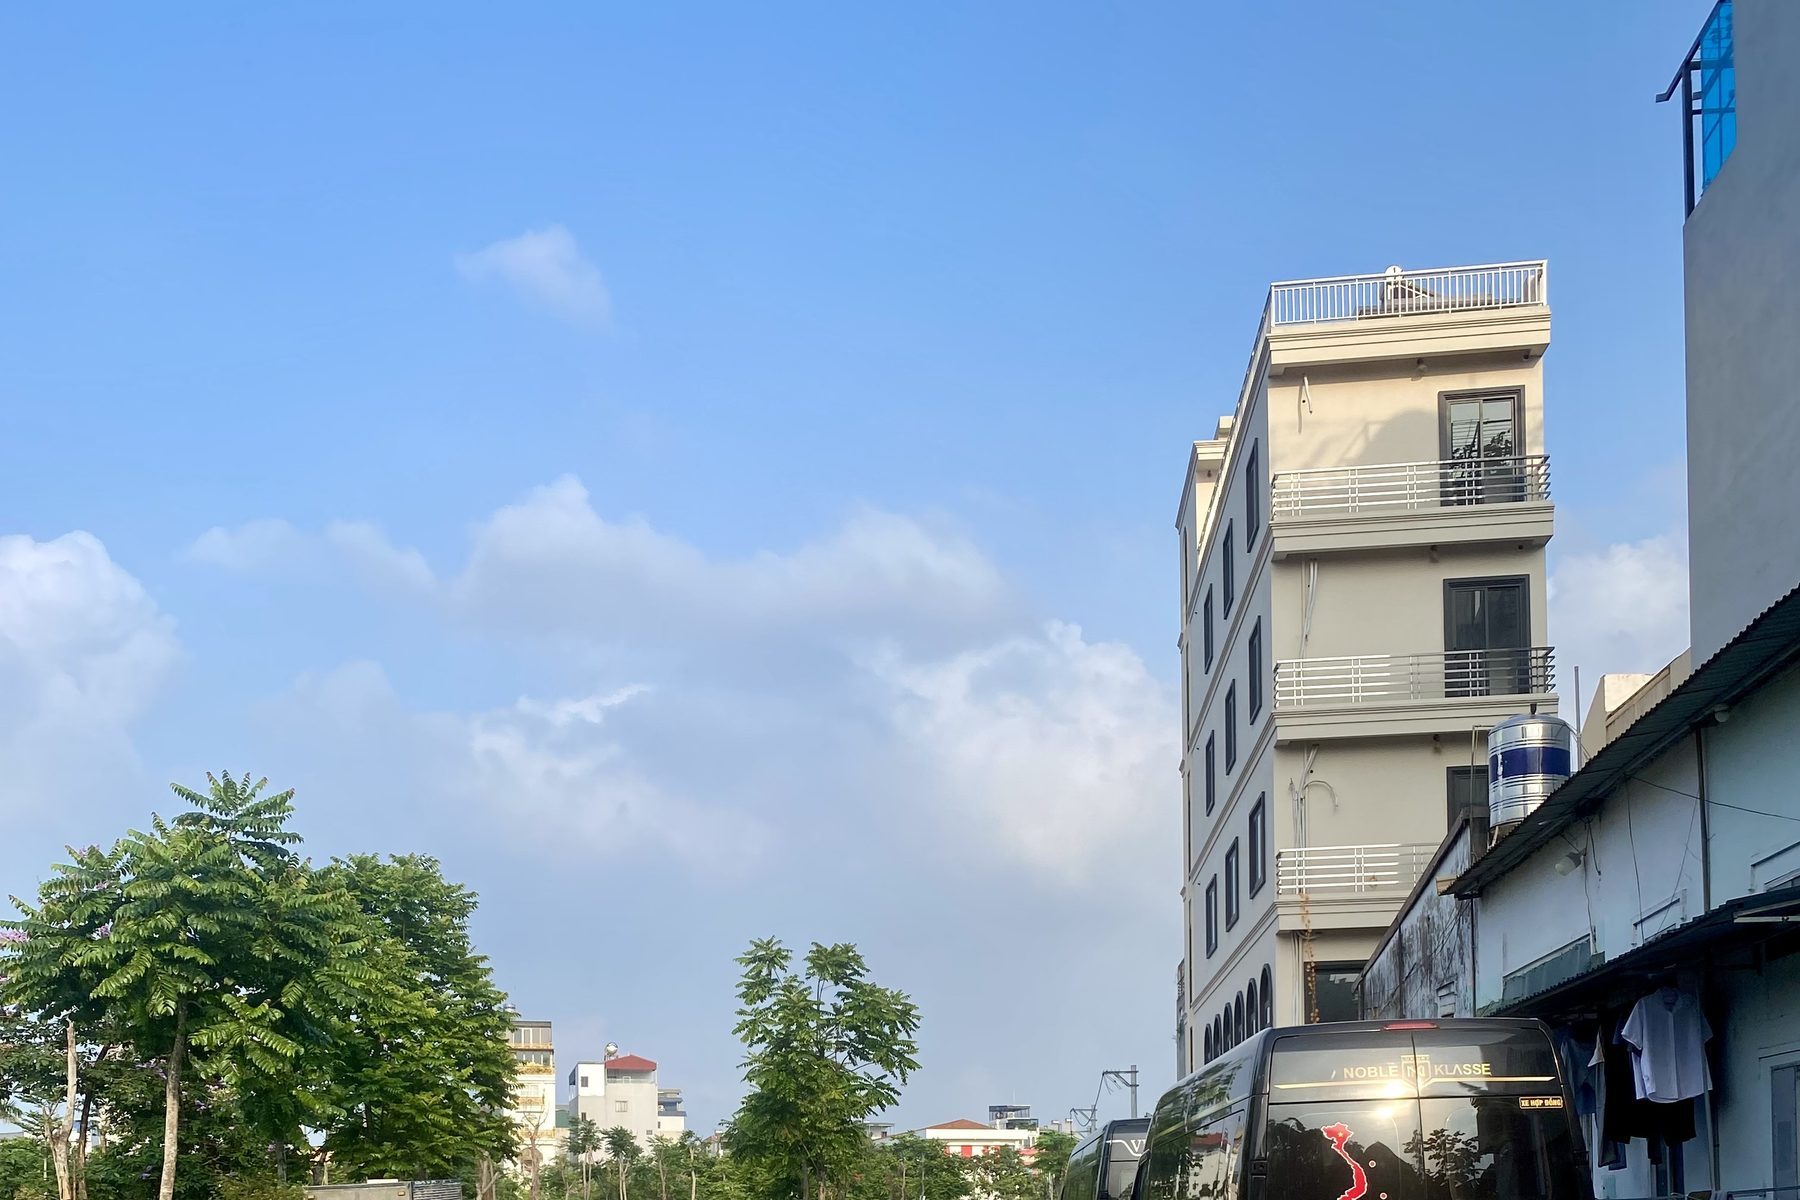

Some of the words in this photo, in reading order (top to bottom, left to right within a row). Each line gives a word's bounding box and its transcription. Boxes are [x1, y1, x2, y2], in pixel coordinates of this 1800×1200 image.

[1343, 1064, 1399, 1079] NOBLE
[1434, 1063, 1491, 1077] KLASSE
[1521, 1099, 1530, 1107] XE
[1530, 1098, 1544, 1108] HỢP
